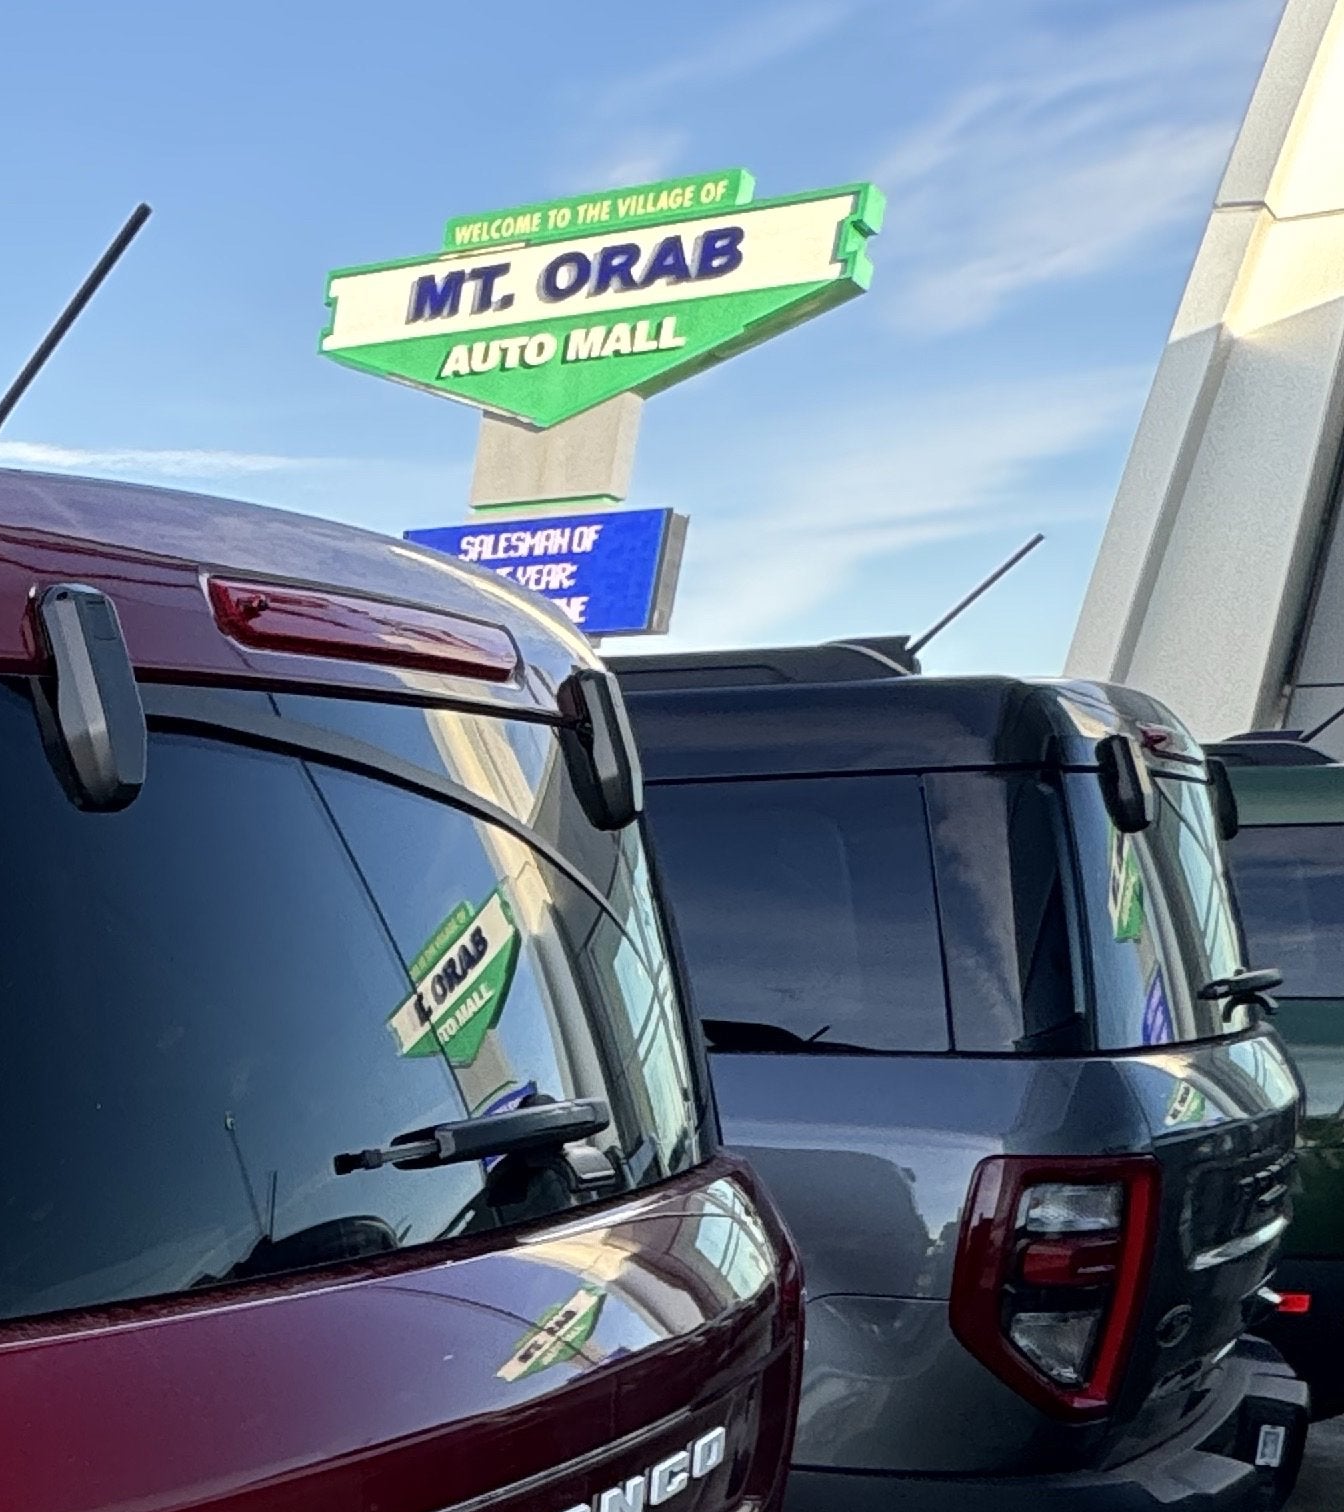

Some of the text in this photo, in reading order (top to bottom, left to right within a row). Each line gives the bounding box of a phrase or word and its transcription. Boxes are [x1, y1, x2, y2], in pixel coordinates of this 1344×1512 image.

[454, 178, 730, 246] WELCOME TO THE VILLAGE OF
[406, 226, 745, 325] MT. ORAB
[437, 315, 687, 380] AUTO MALL
[458, 524, 603, 561] SALESMAN OF
